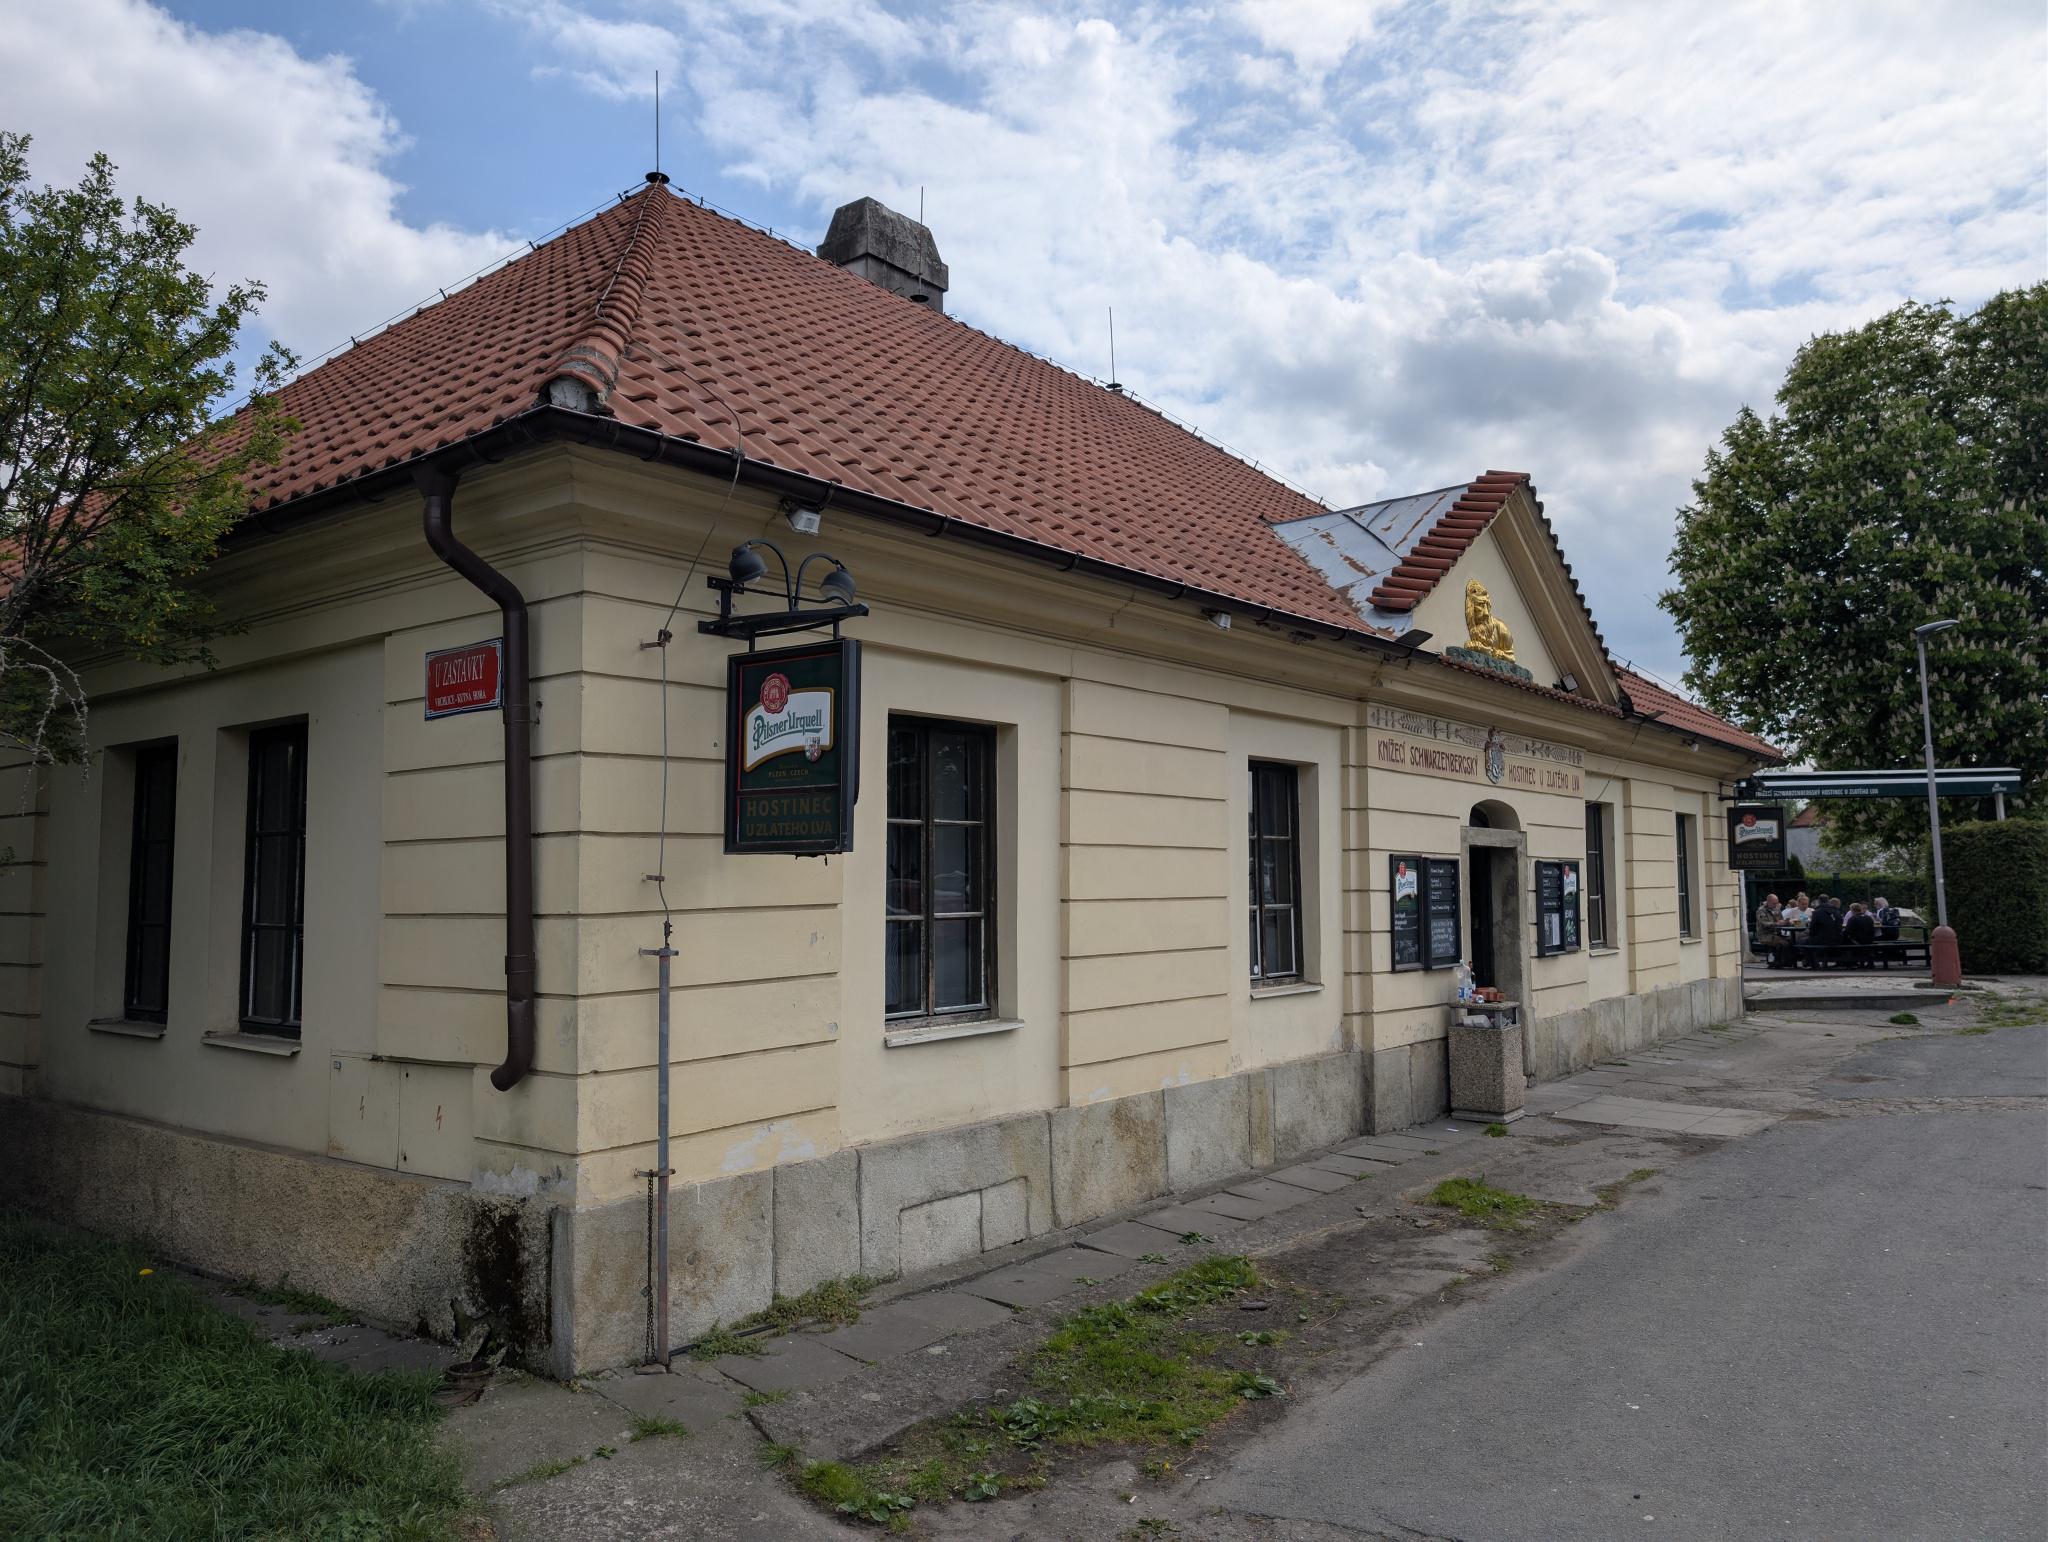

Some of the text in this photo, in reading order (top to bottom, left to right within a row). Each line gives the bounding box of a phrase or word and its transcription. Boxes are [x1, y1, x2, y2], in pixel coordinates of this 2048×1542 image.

[435, 663, 441, 688] U
[752, 709, 823, 750] Pilsner Urquell
[1377, 738, 1580, 792] KNÍŽECÍ SCHWARZENBERGSKÝ HOSTINEC U ZLATÉHO LVA
[746, 796, 833, 817] HOSTINEC
